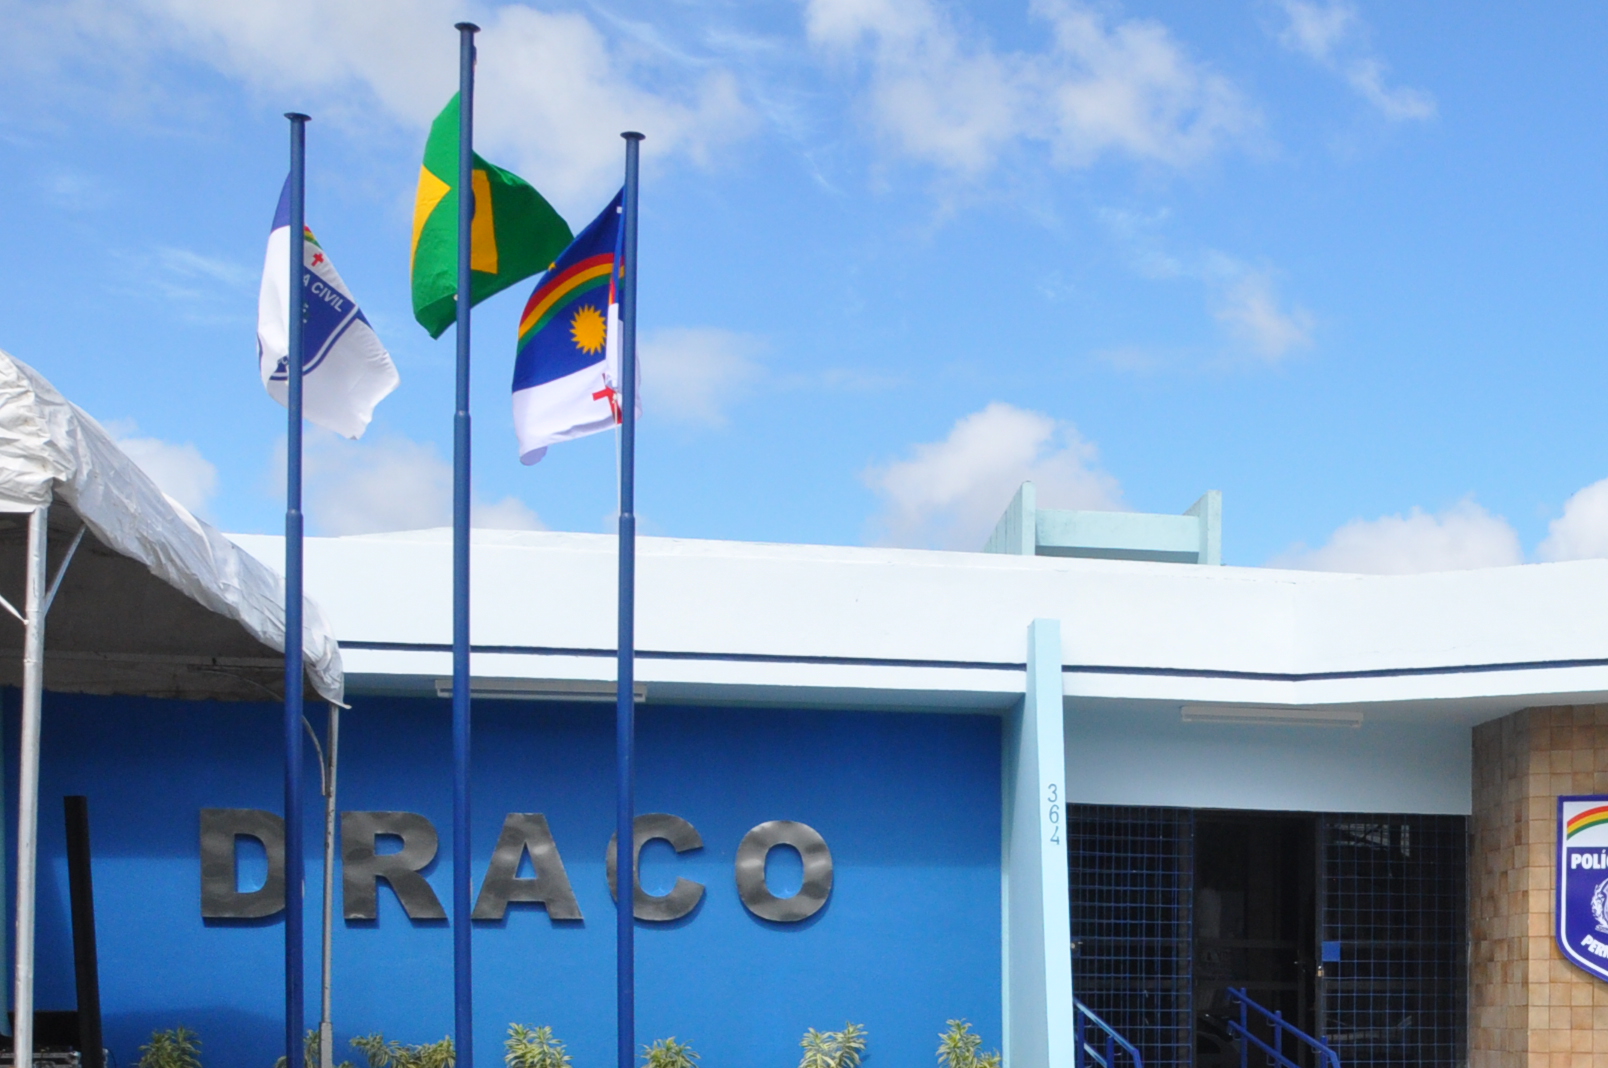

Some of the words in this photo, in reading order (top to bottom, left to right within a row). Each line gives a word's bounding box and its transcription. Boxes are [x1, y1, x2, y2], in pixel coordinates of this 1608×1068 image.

[311, 281, 343, 312] CIVIL
[1047, 783, 1060, 845] 364
[199, 807, 833, 922] DRACO
